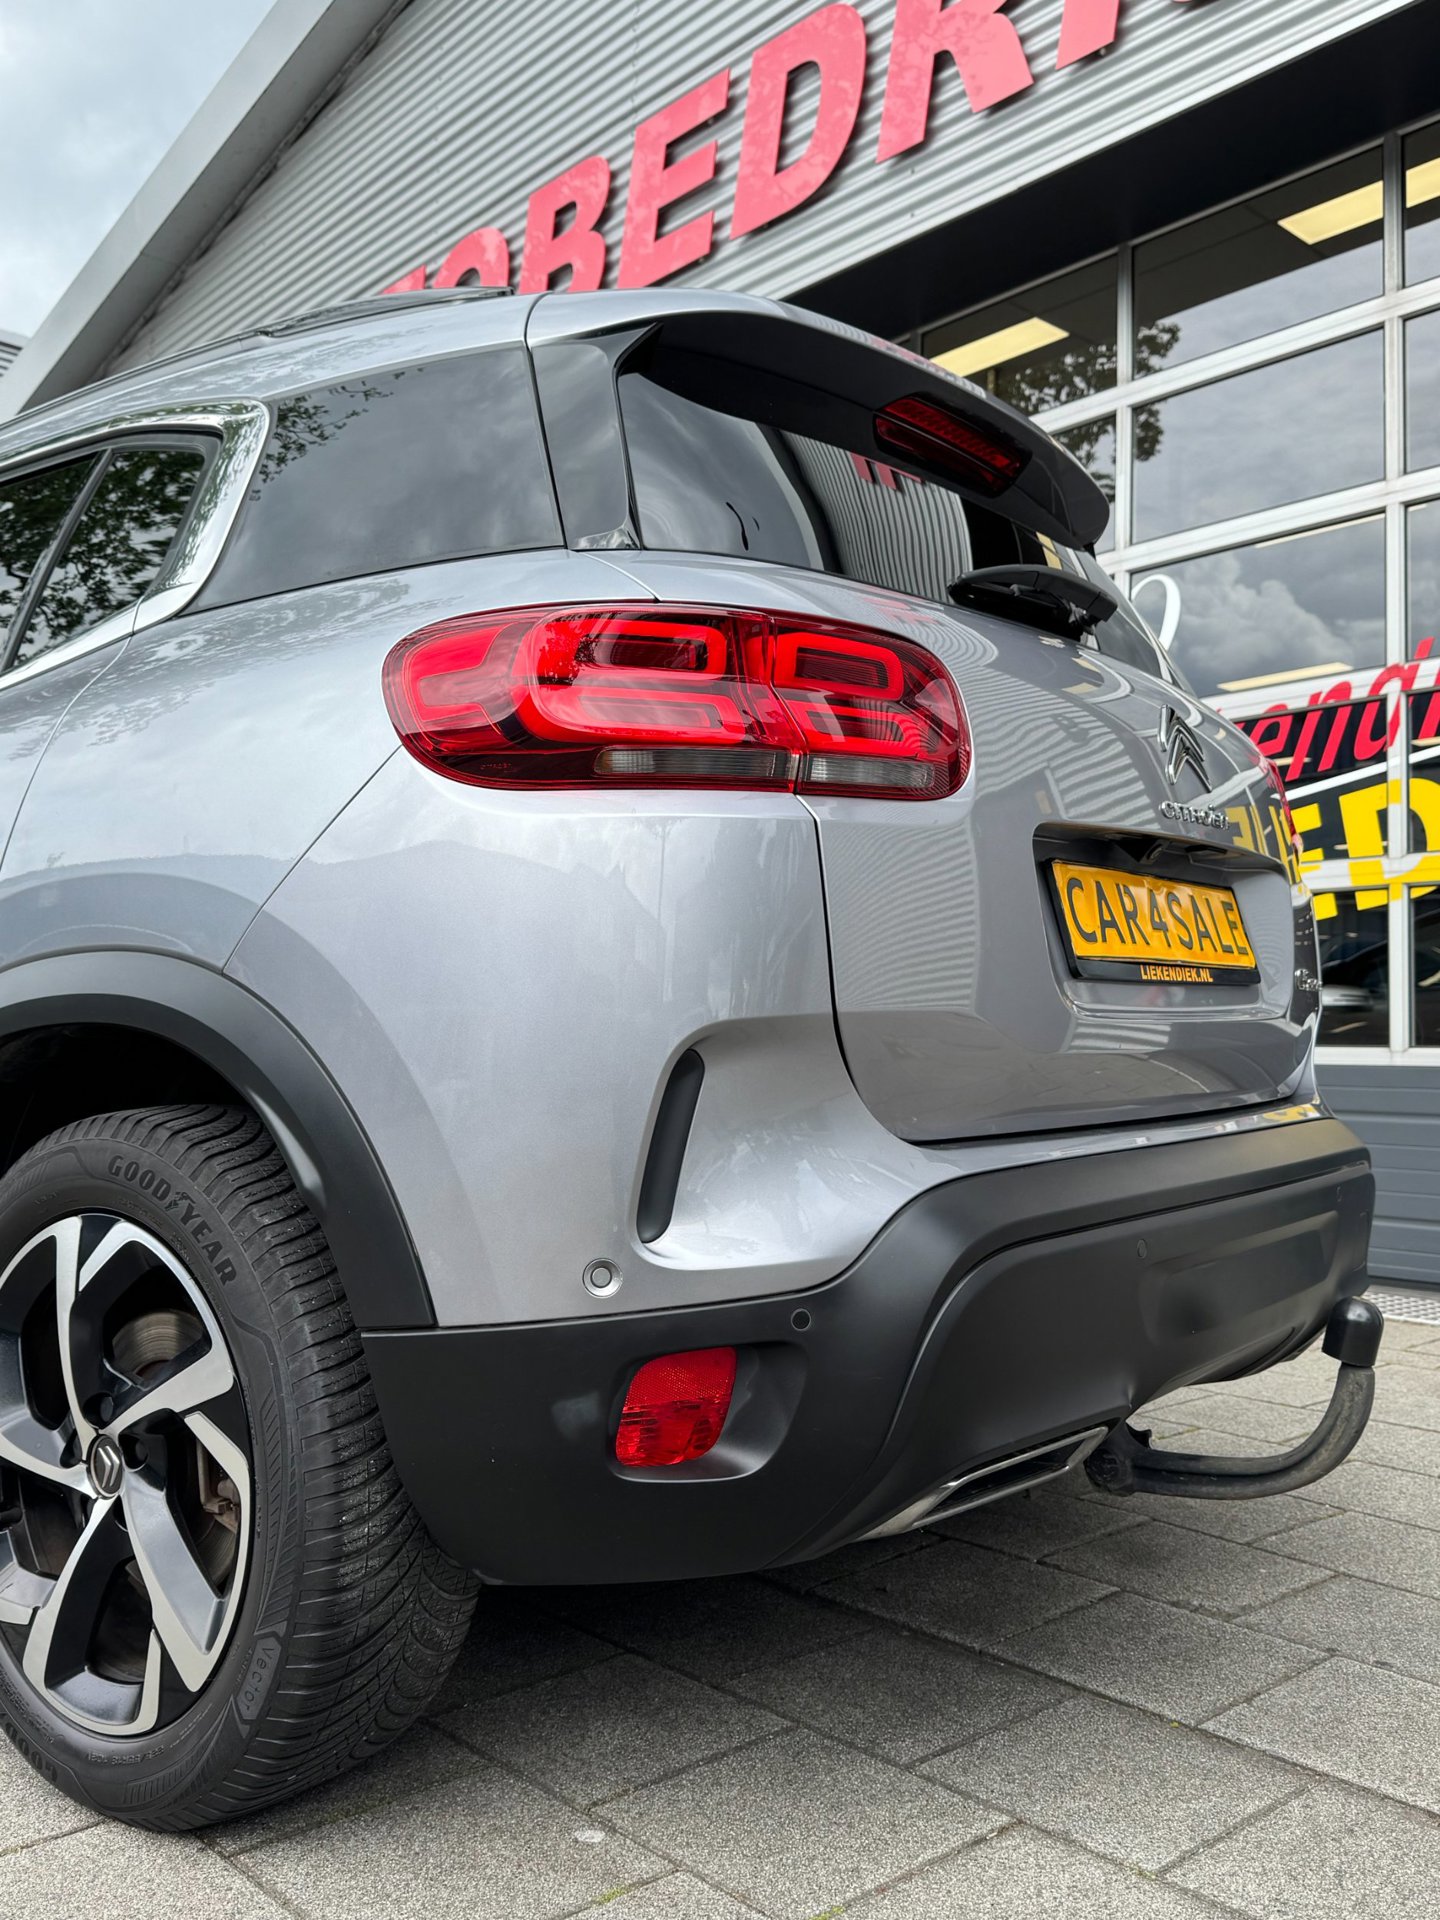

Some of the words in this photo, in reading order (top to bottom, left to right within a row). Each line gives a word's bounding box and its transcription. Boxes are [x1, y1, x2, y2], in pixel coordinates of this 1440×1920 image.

[380, 0, 1119, 294] BEDR
[1234, 636, 1440, 782] end
[1066, 877, 1249, 956] CAR4SALE
[1140, 964, 1214, 983] LIEKENDIEK.NL
[107, 1154, 238, 1287] GOODYEAR
[240, 1647, 275, 1712] Vector
